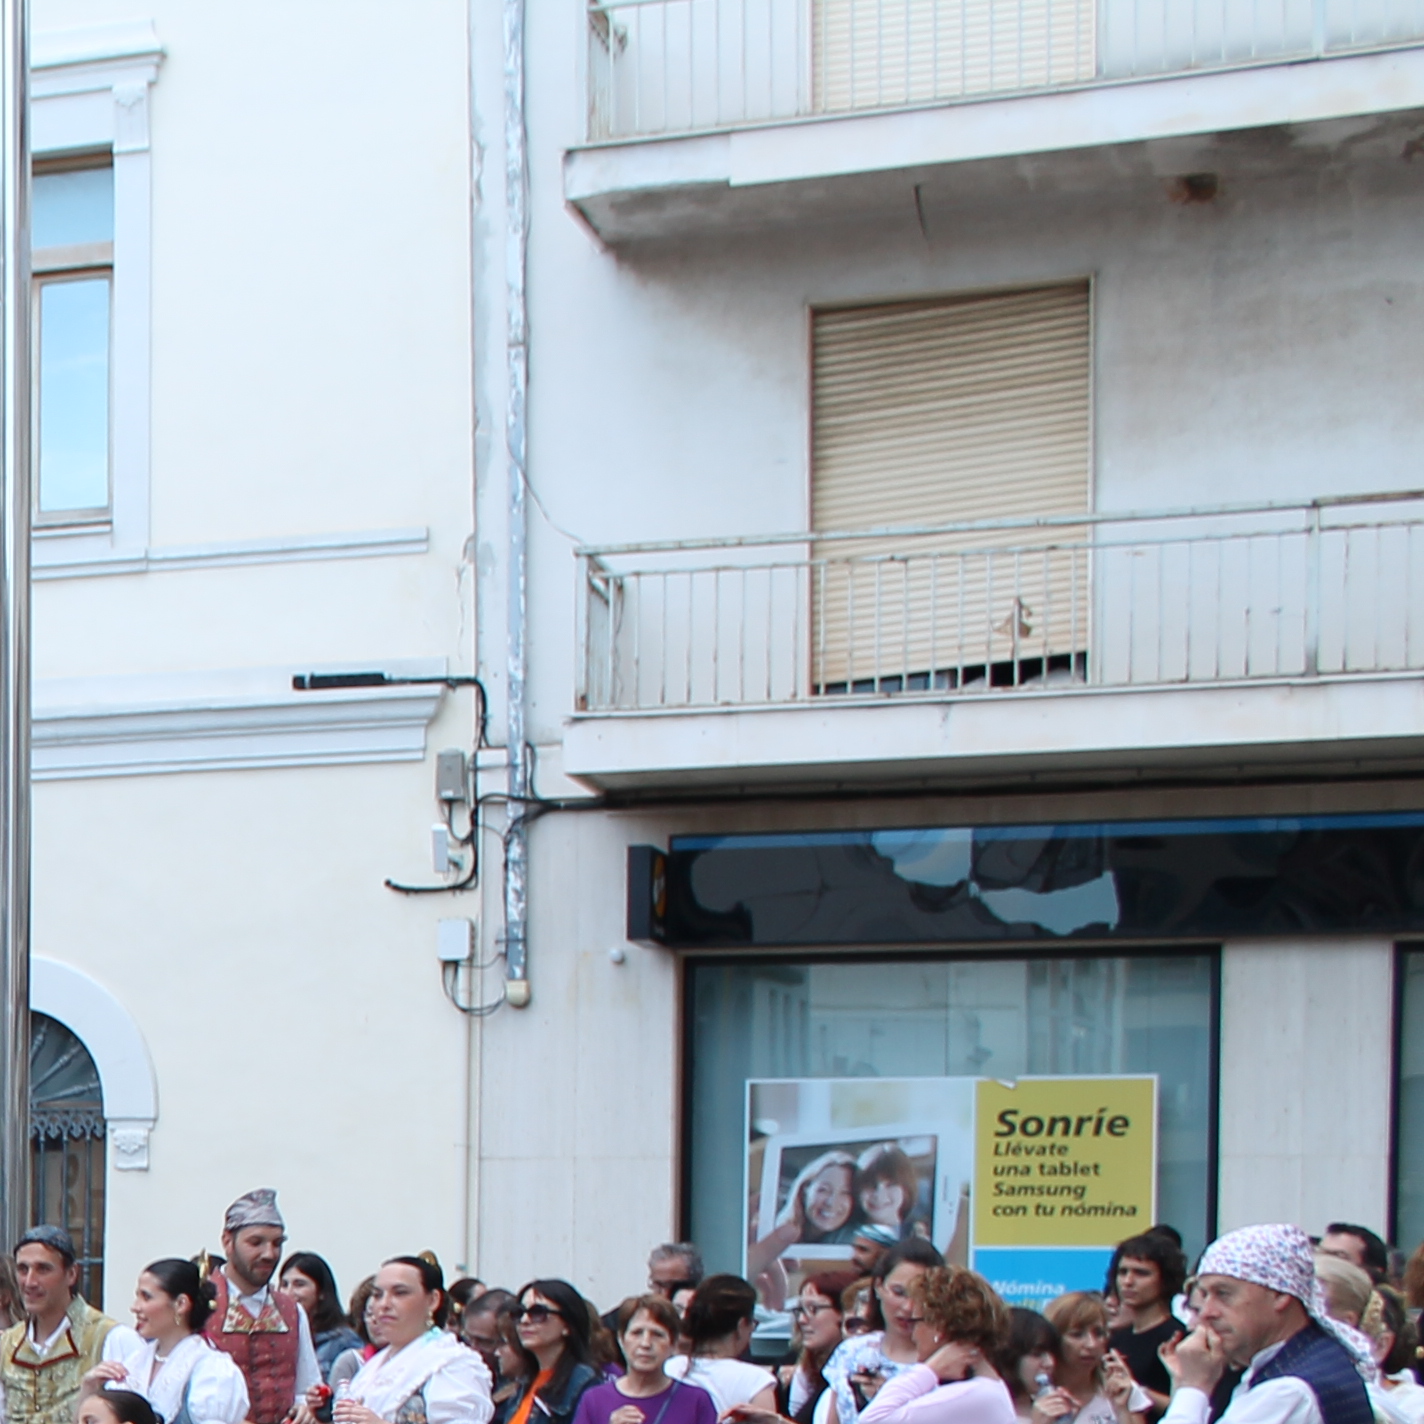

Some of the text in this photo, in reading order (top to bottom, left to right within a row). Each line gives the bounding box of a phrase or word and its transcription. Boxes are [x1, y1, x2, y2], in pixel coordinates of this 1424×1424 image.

[993, 1107, 1130, 1137] Sonríe
[993, 1142, 1069, 1157] Llévate
[993, 1161, 1101, 1176] una tablet
[993, 1182, 1087, 1200] Samsung
[992, 1201, 1138, 1217] con tu nómina
[992, 1279, 1066, 1296] Nómina
